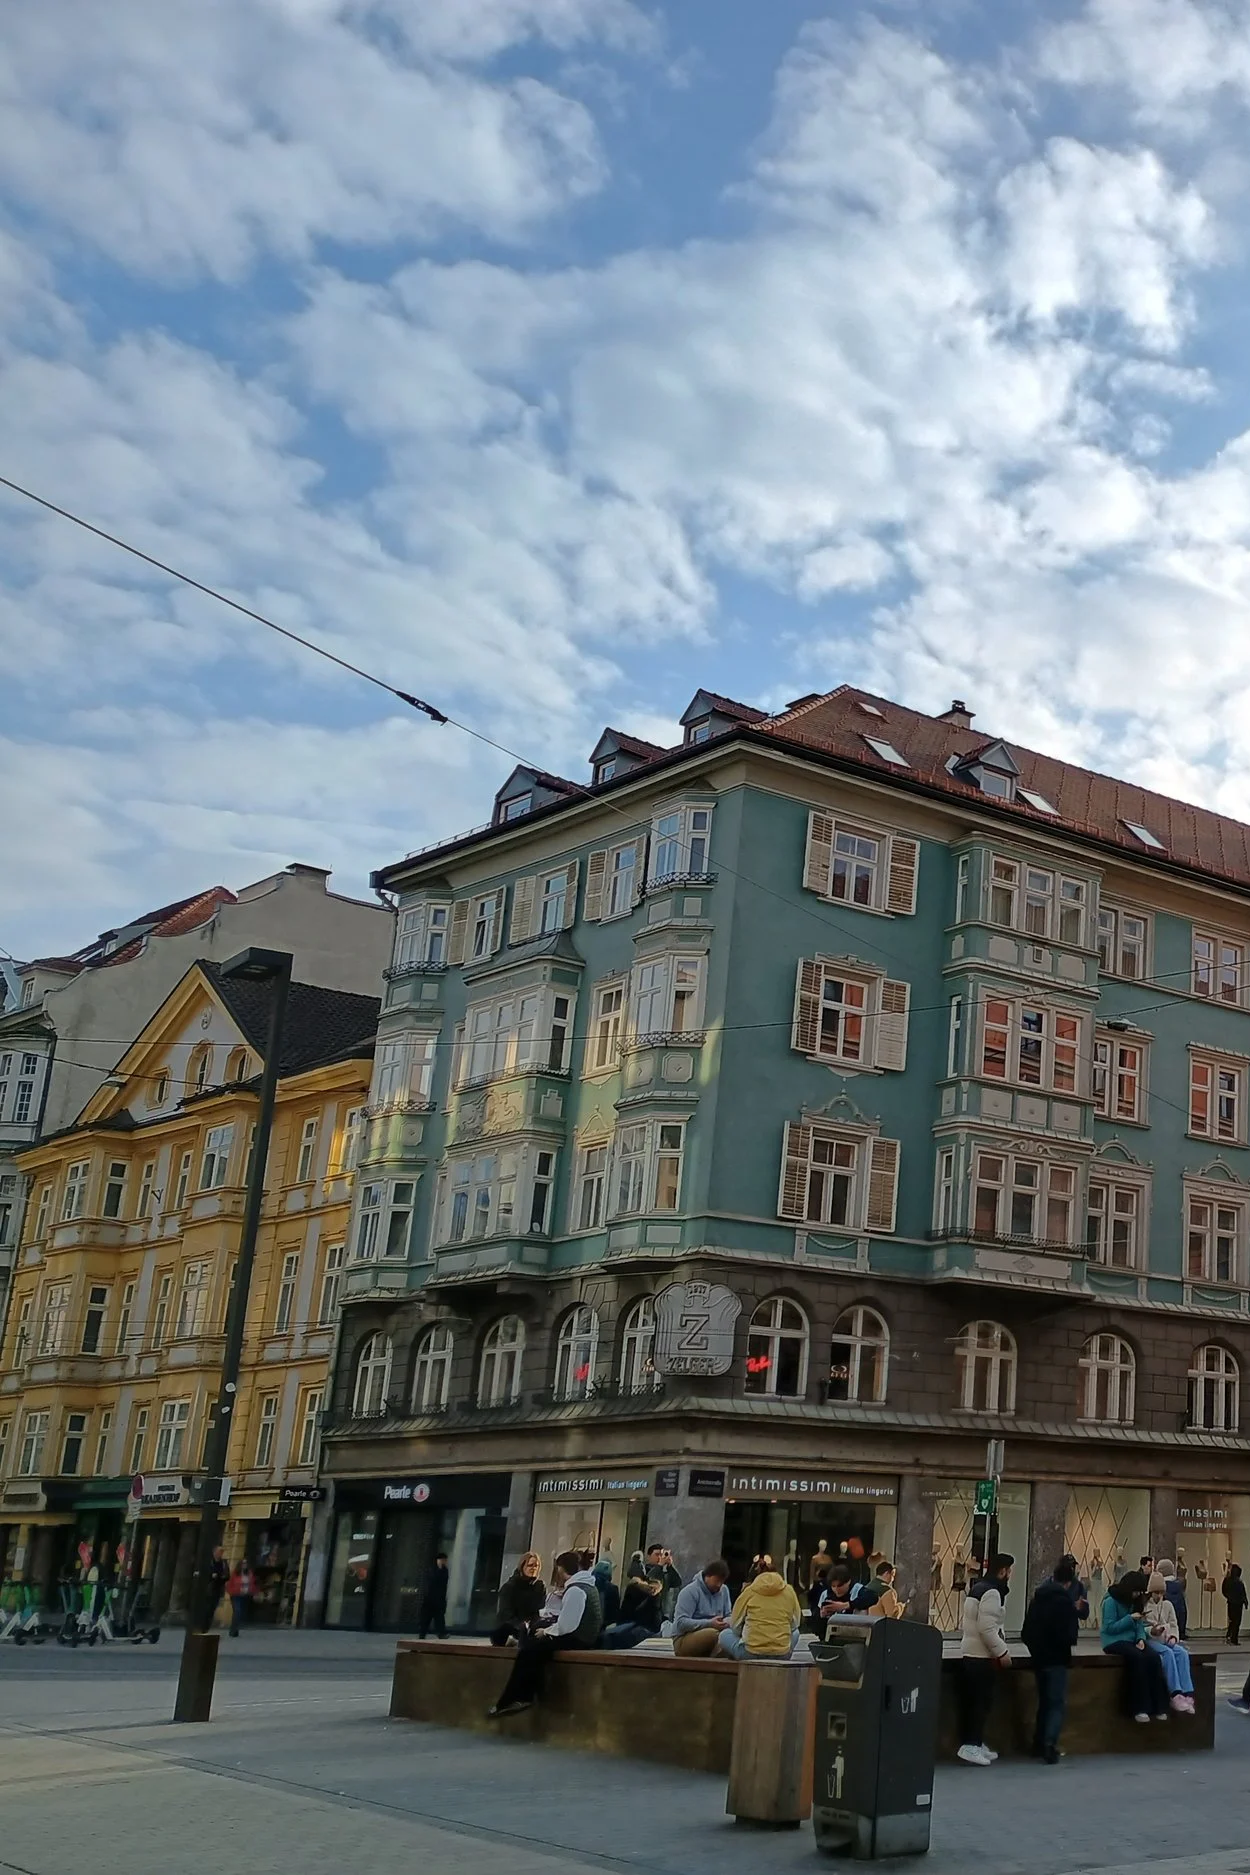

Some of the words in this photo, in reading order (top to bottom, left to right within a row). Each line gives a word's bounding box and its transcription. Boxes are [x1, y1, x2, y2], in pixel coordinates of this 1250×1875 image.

[678, 1313, 710, 1351] Z
[384, 1485, 411, 1500] Pearle
[538, 1478, 603, 1492] intimissimi
[732, 1476, 836, 1493] intimissimi
[840, 1486, 864, 1494] Italian
[866, 1486, 894, 1496] lingerie
